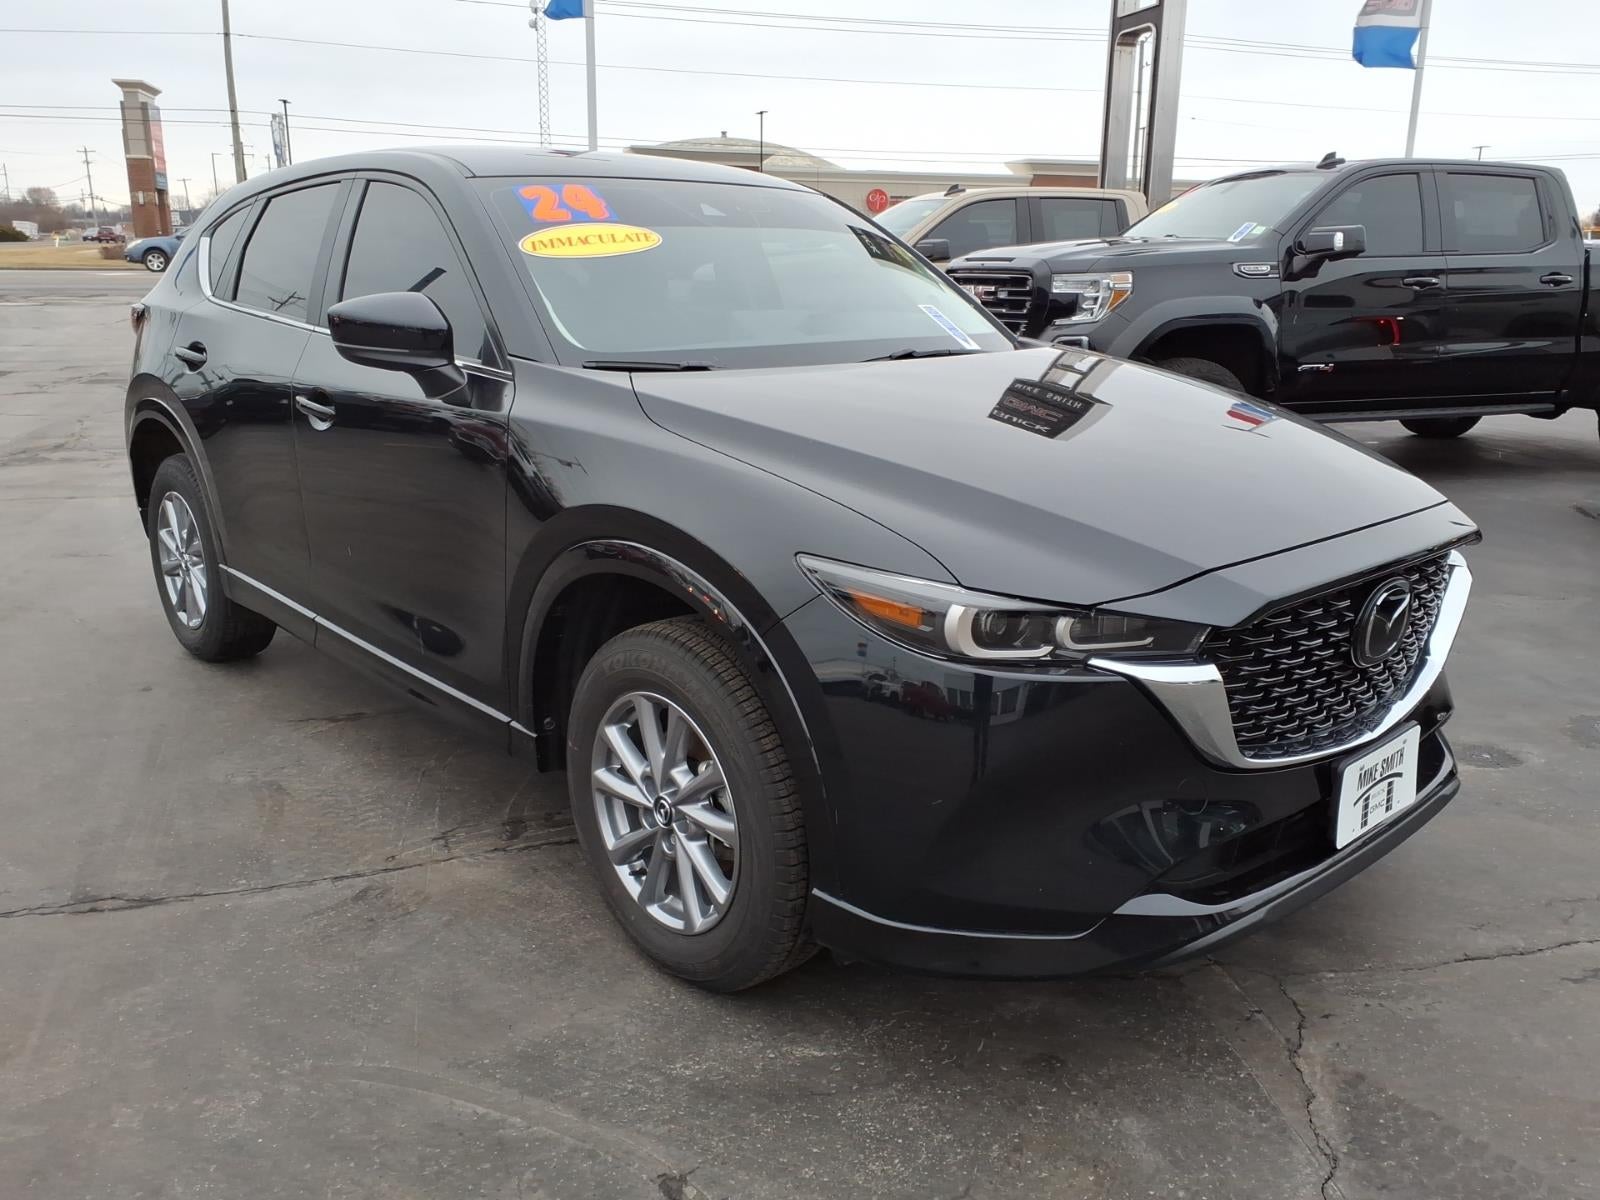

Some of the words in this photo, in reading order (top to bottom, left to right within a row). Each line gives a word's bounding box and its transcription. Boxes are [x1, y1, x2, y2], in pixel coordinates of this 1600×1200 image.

[518, 184, 610, 221] 24
[530, 232, 656, 252] IMMACULATE
[1357, 762, 1379, 791] MIKE
[1380, 747, 1405, 777] SMITH
